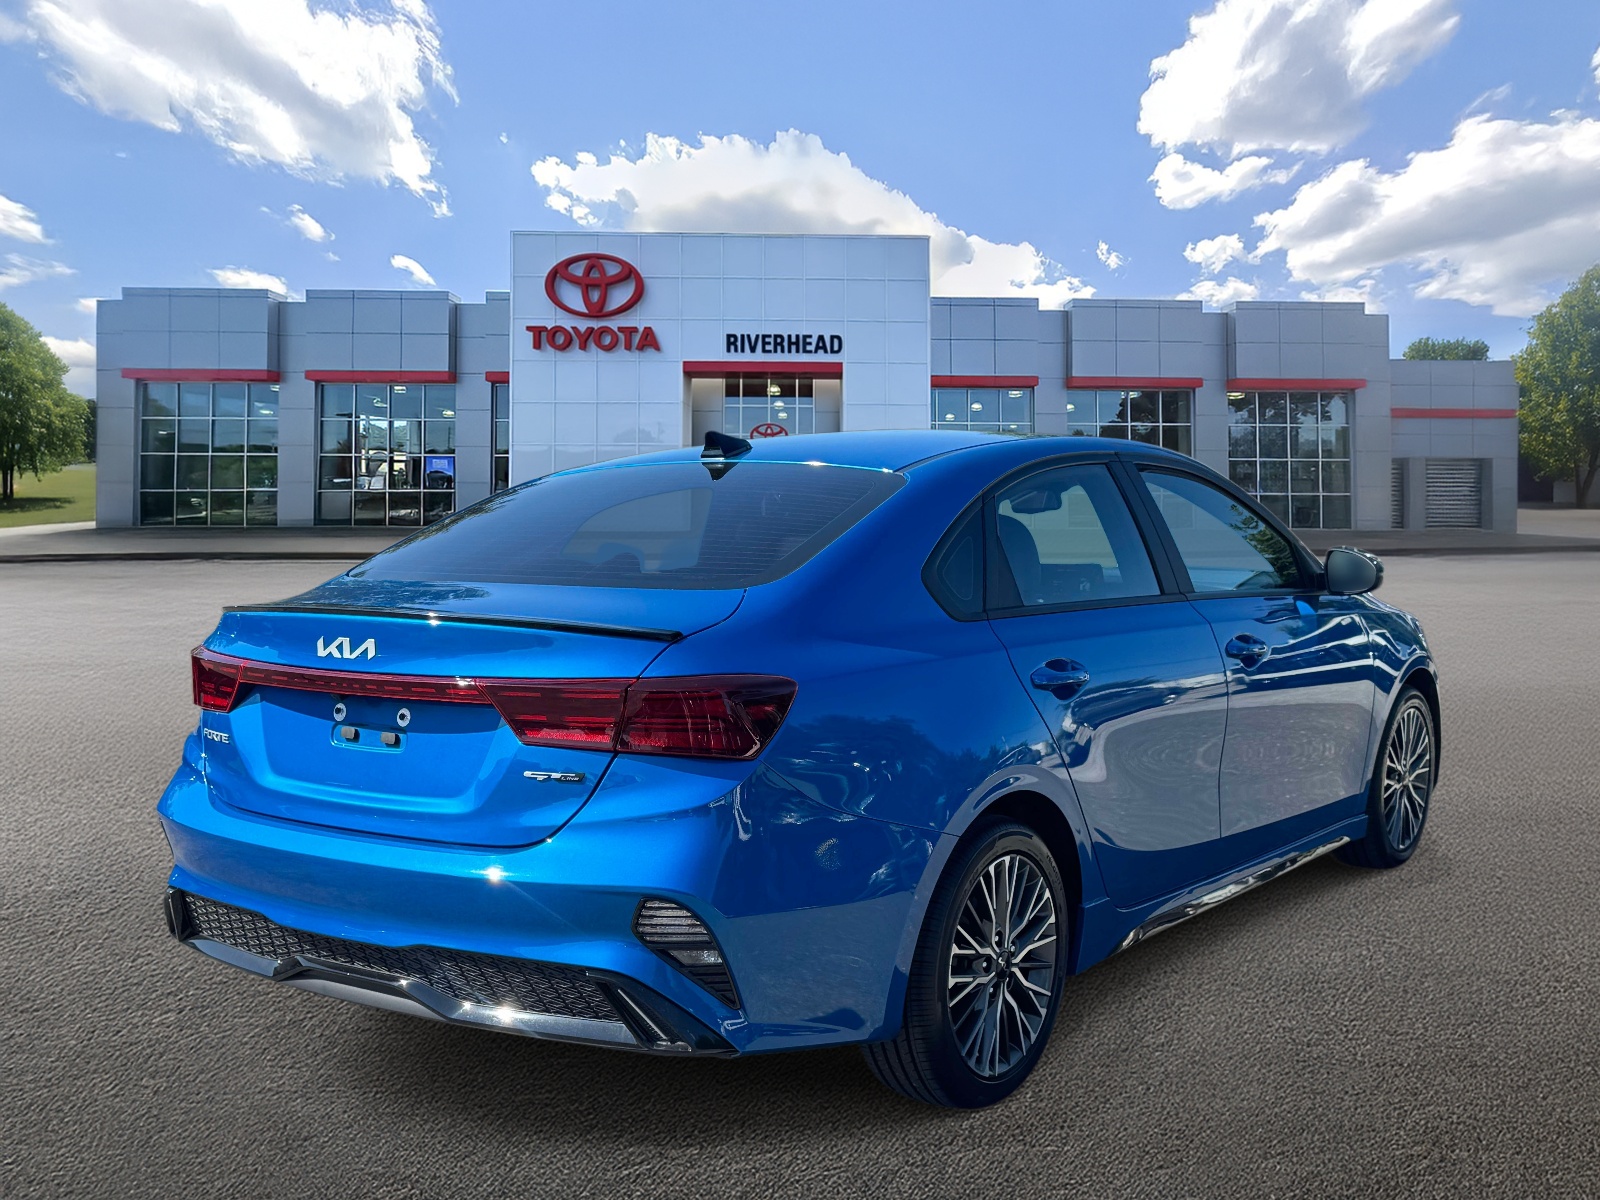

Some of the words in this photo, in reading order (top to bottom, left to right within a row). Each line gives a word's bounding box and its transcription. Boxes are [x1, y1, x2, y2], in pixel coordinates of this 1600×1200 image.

[526, 325, 661, 351] TOYOTA
[726, 333, 843, 354] RIVERHEAD
[317, 636, 376, 660] KIA
[203, 727, 230, 744] FORTE
